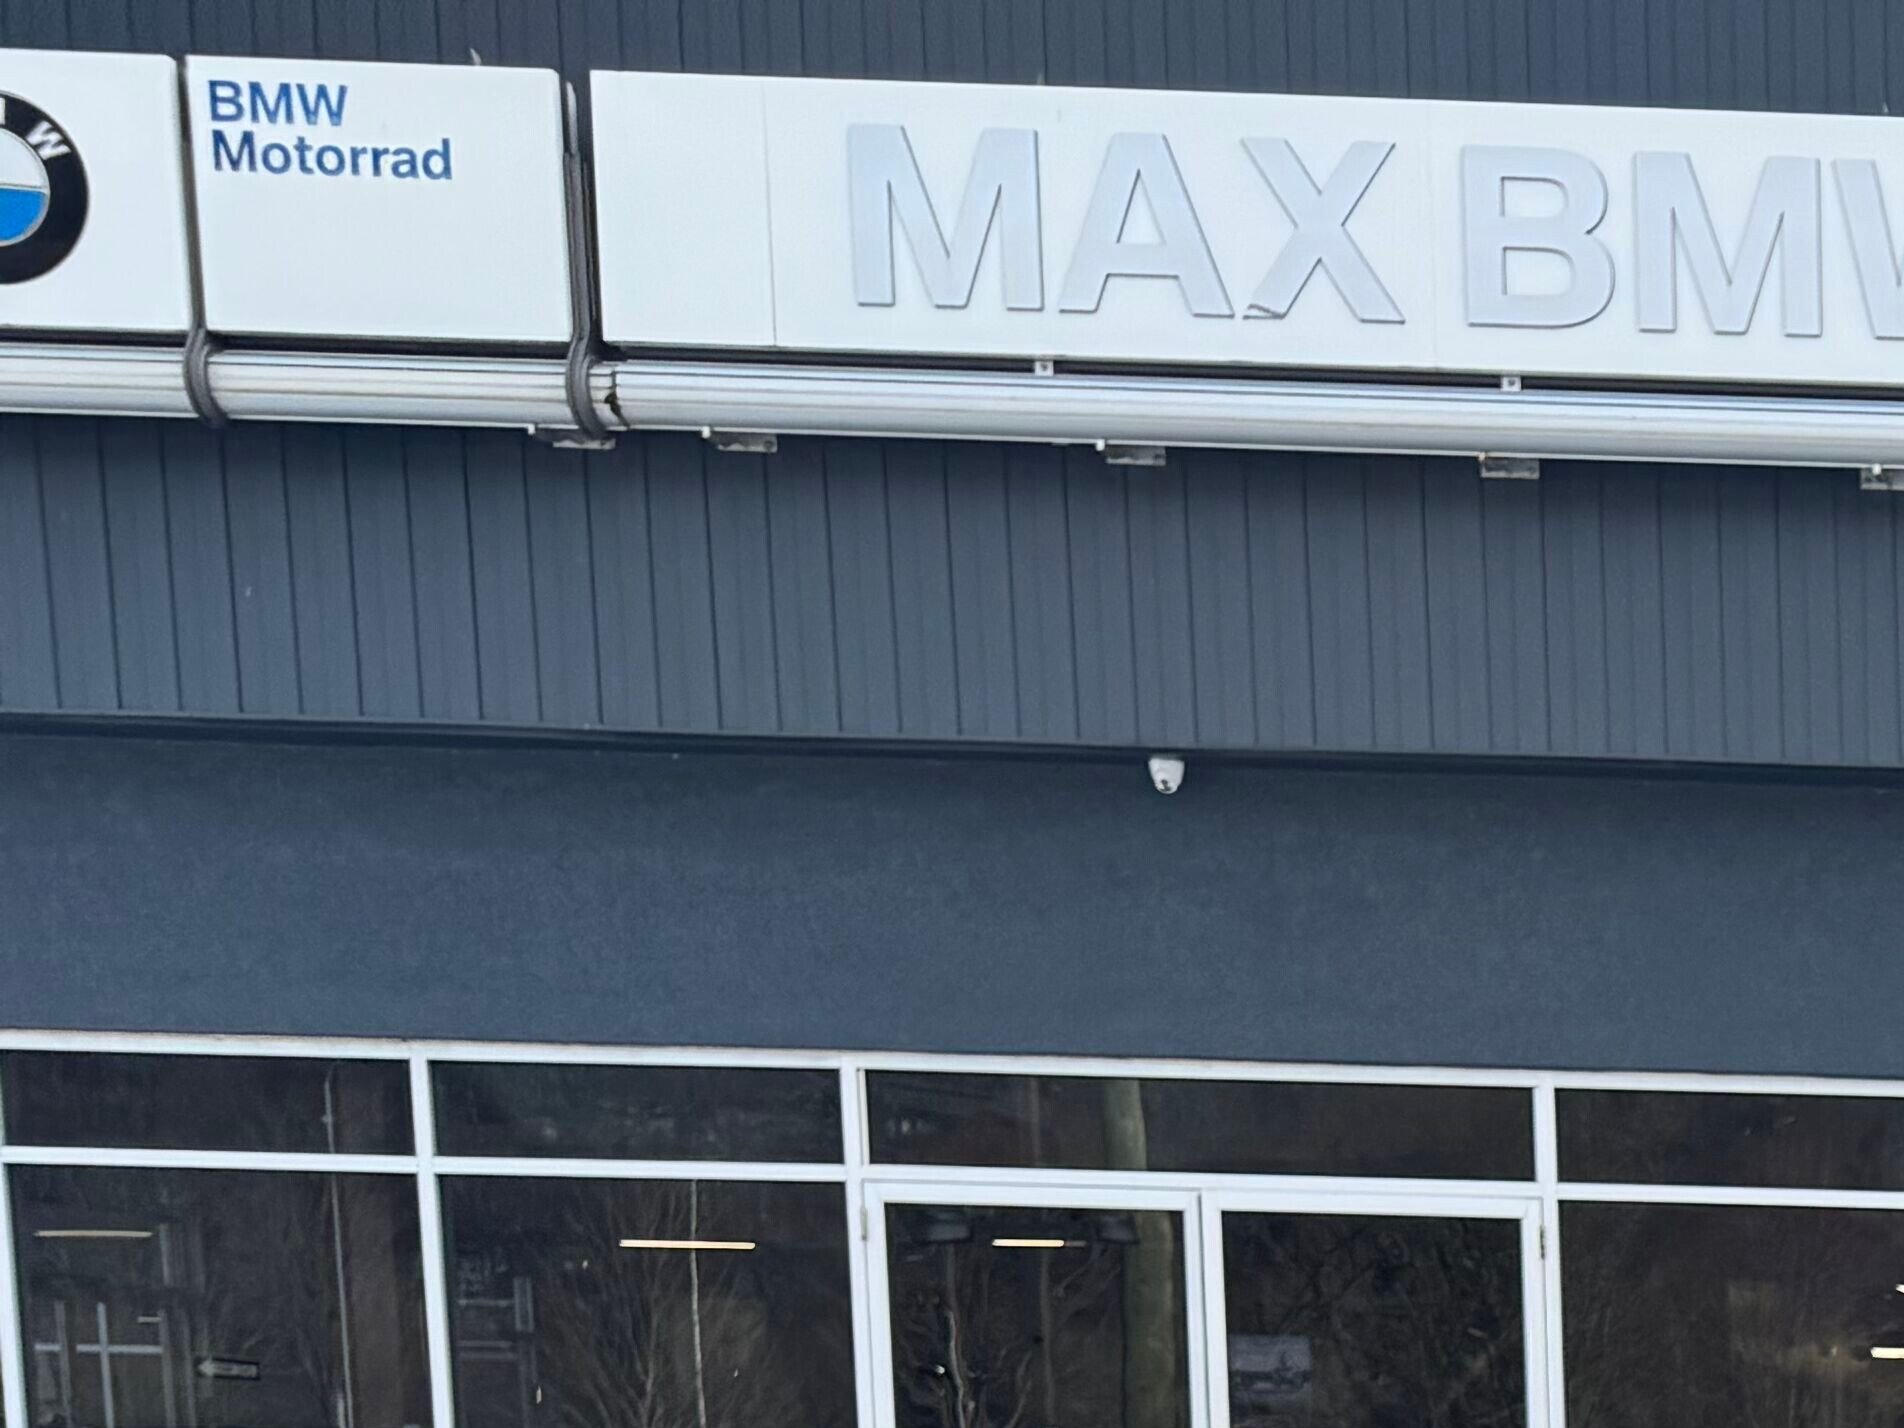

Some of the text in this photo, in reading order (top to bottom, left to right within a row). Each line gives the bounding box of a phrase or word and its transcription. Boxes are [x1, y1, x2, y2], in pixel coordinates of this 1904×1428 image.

[208, 80, 348, 126] BMW
[211, 129, 453, 180] Motorrad
[846, 122, 1406, 324] MAX
